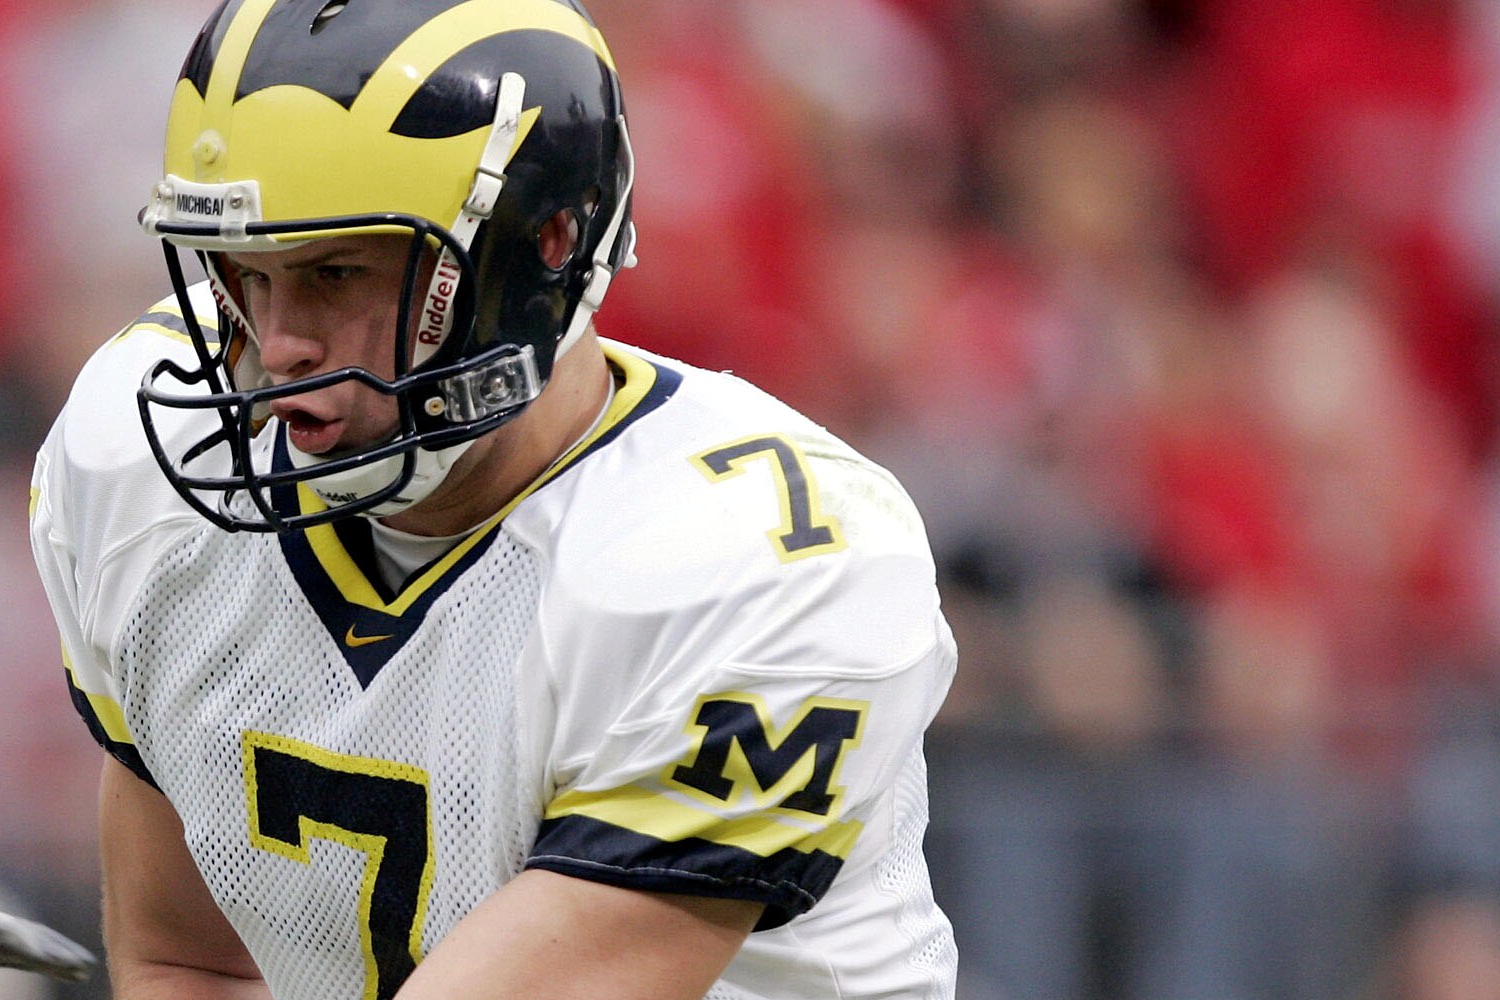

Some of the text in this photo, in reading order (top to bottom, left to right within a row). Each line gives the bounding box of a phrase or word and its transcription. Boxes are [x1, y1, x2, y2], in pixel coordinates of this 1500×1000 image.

[418, 261, 461, 346] Riddell
[687, 432, 848, 564] 7
[665, 691, 871, 818] M
